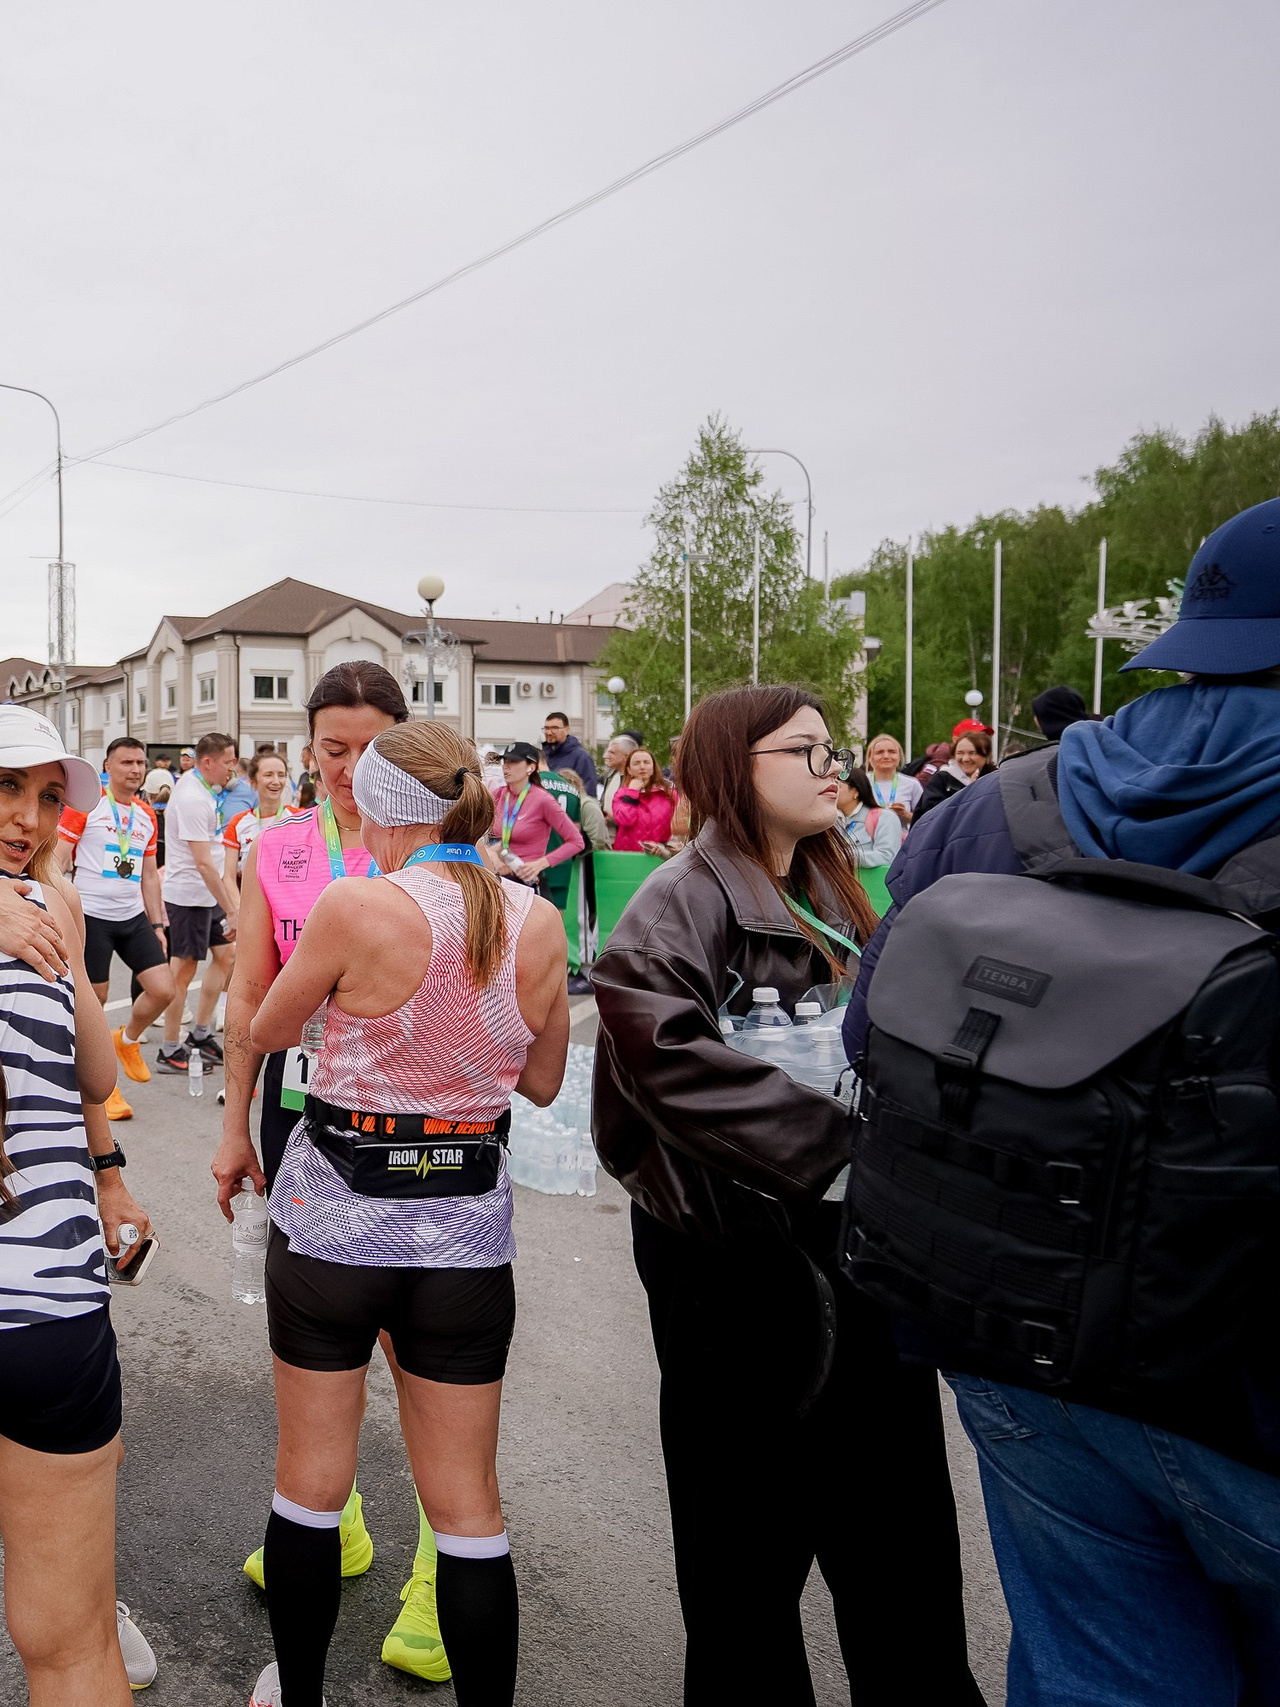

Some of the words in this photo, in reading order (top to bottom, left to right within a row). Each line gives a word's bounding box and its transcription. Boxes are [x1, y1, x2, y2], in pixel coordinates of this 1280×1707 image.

[445, 847, 462, 855] Utair
[113, 855, 136, 870] 95
[983, 969, 1028, 990] TENBA
[388, 1150, 418, 1165] IRON
[432, 1149, 463, 1164] STAR
